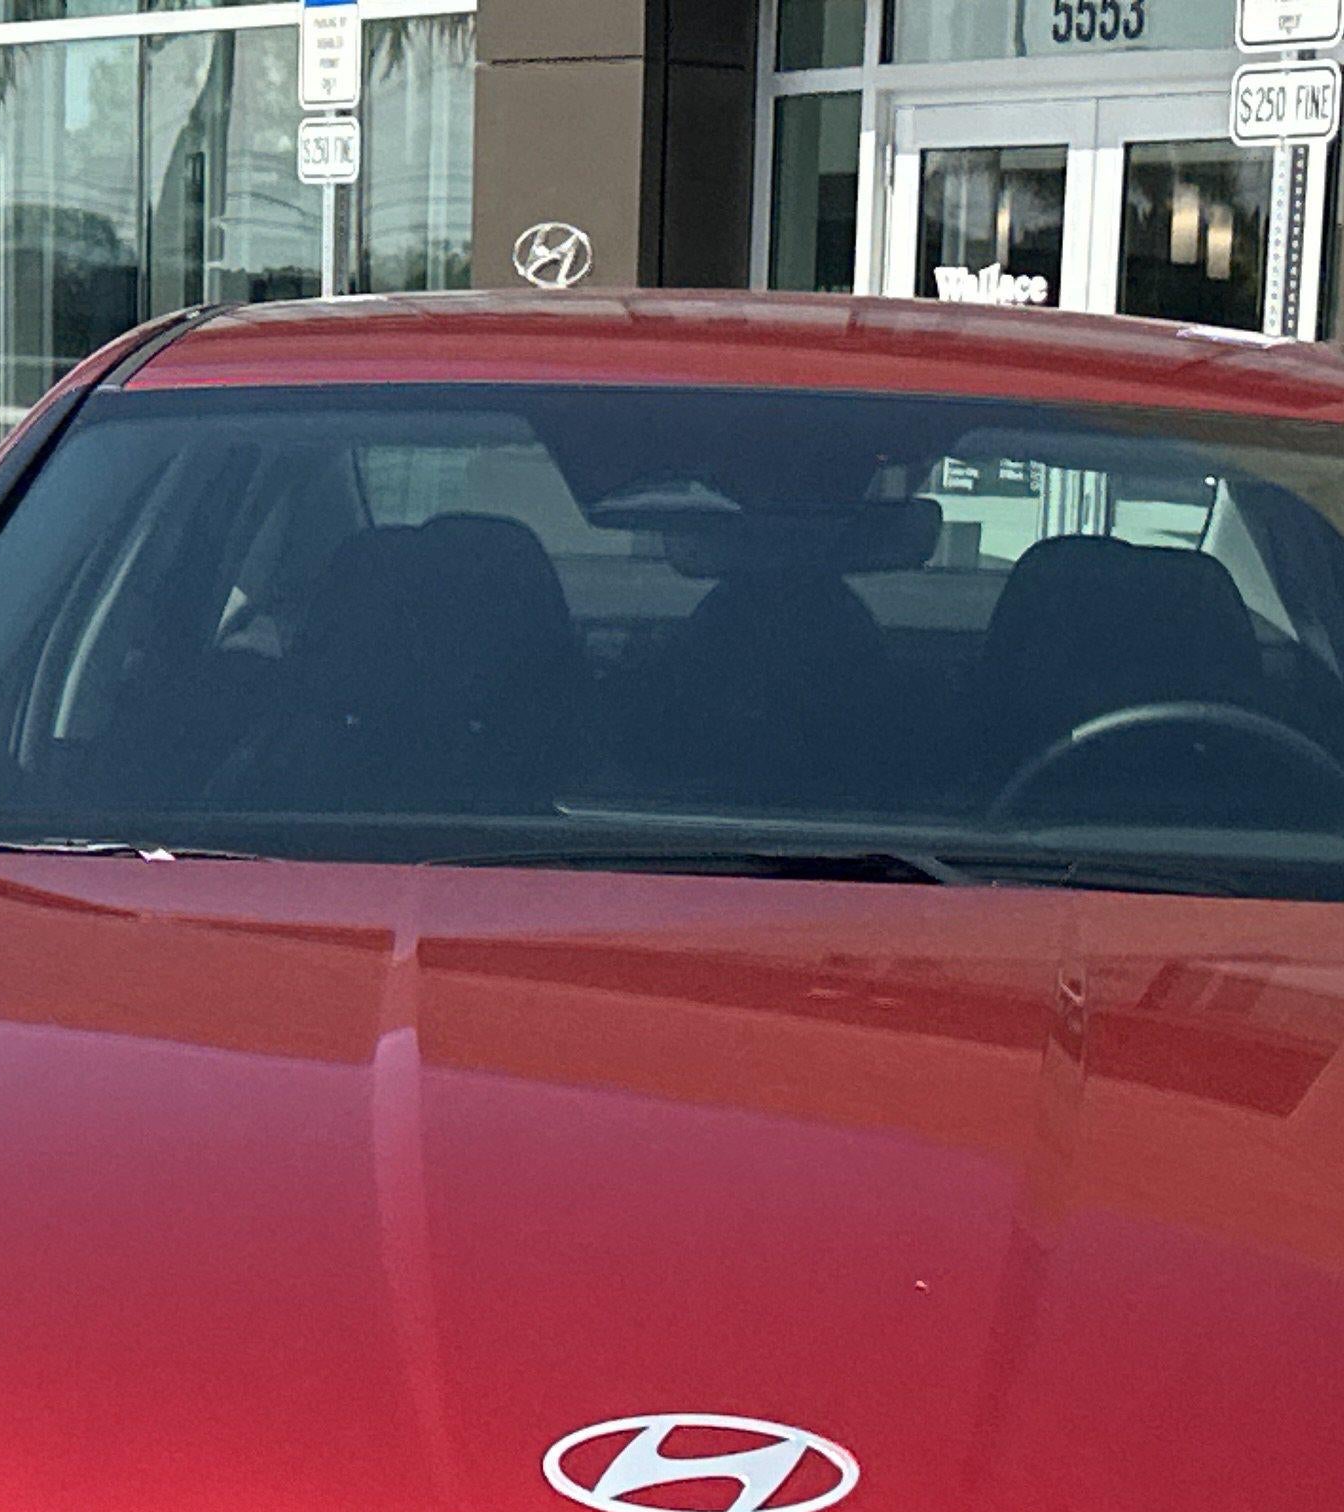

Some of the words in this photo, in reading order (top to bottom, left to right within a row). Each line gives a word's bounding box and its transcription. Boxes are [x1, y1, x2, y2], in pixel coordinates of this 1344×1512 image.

[1052, 0, 1145, 43] 5553
[1239, 86, 1287, 125] $250
[1295, 84, 1331, 120] FINE
